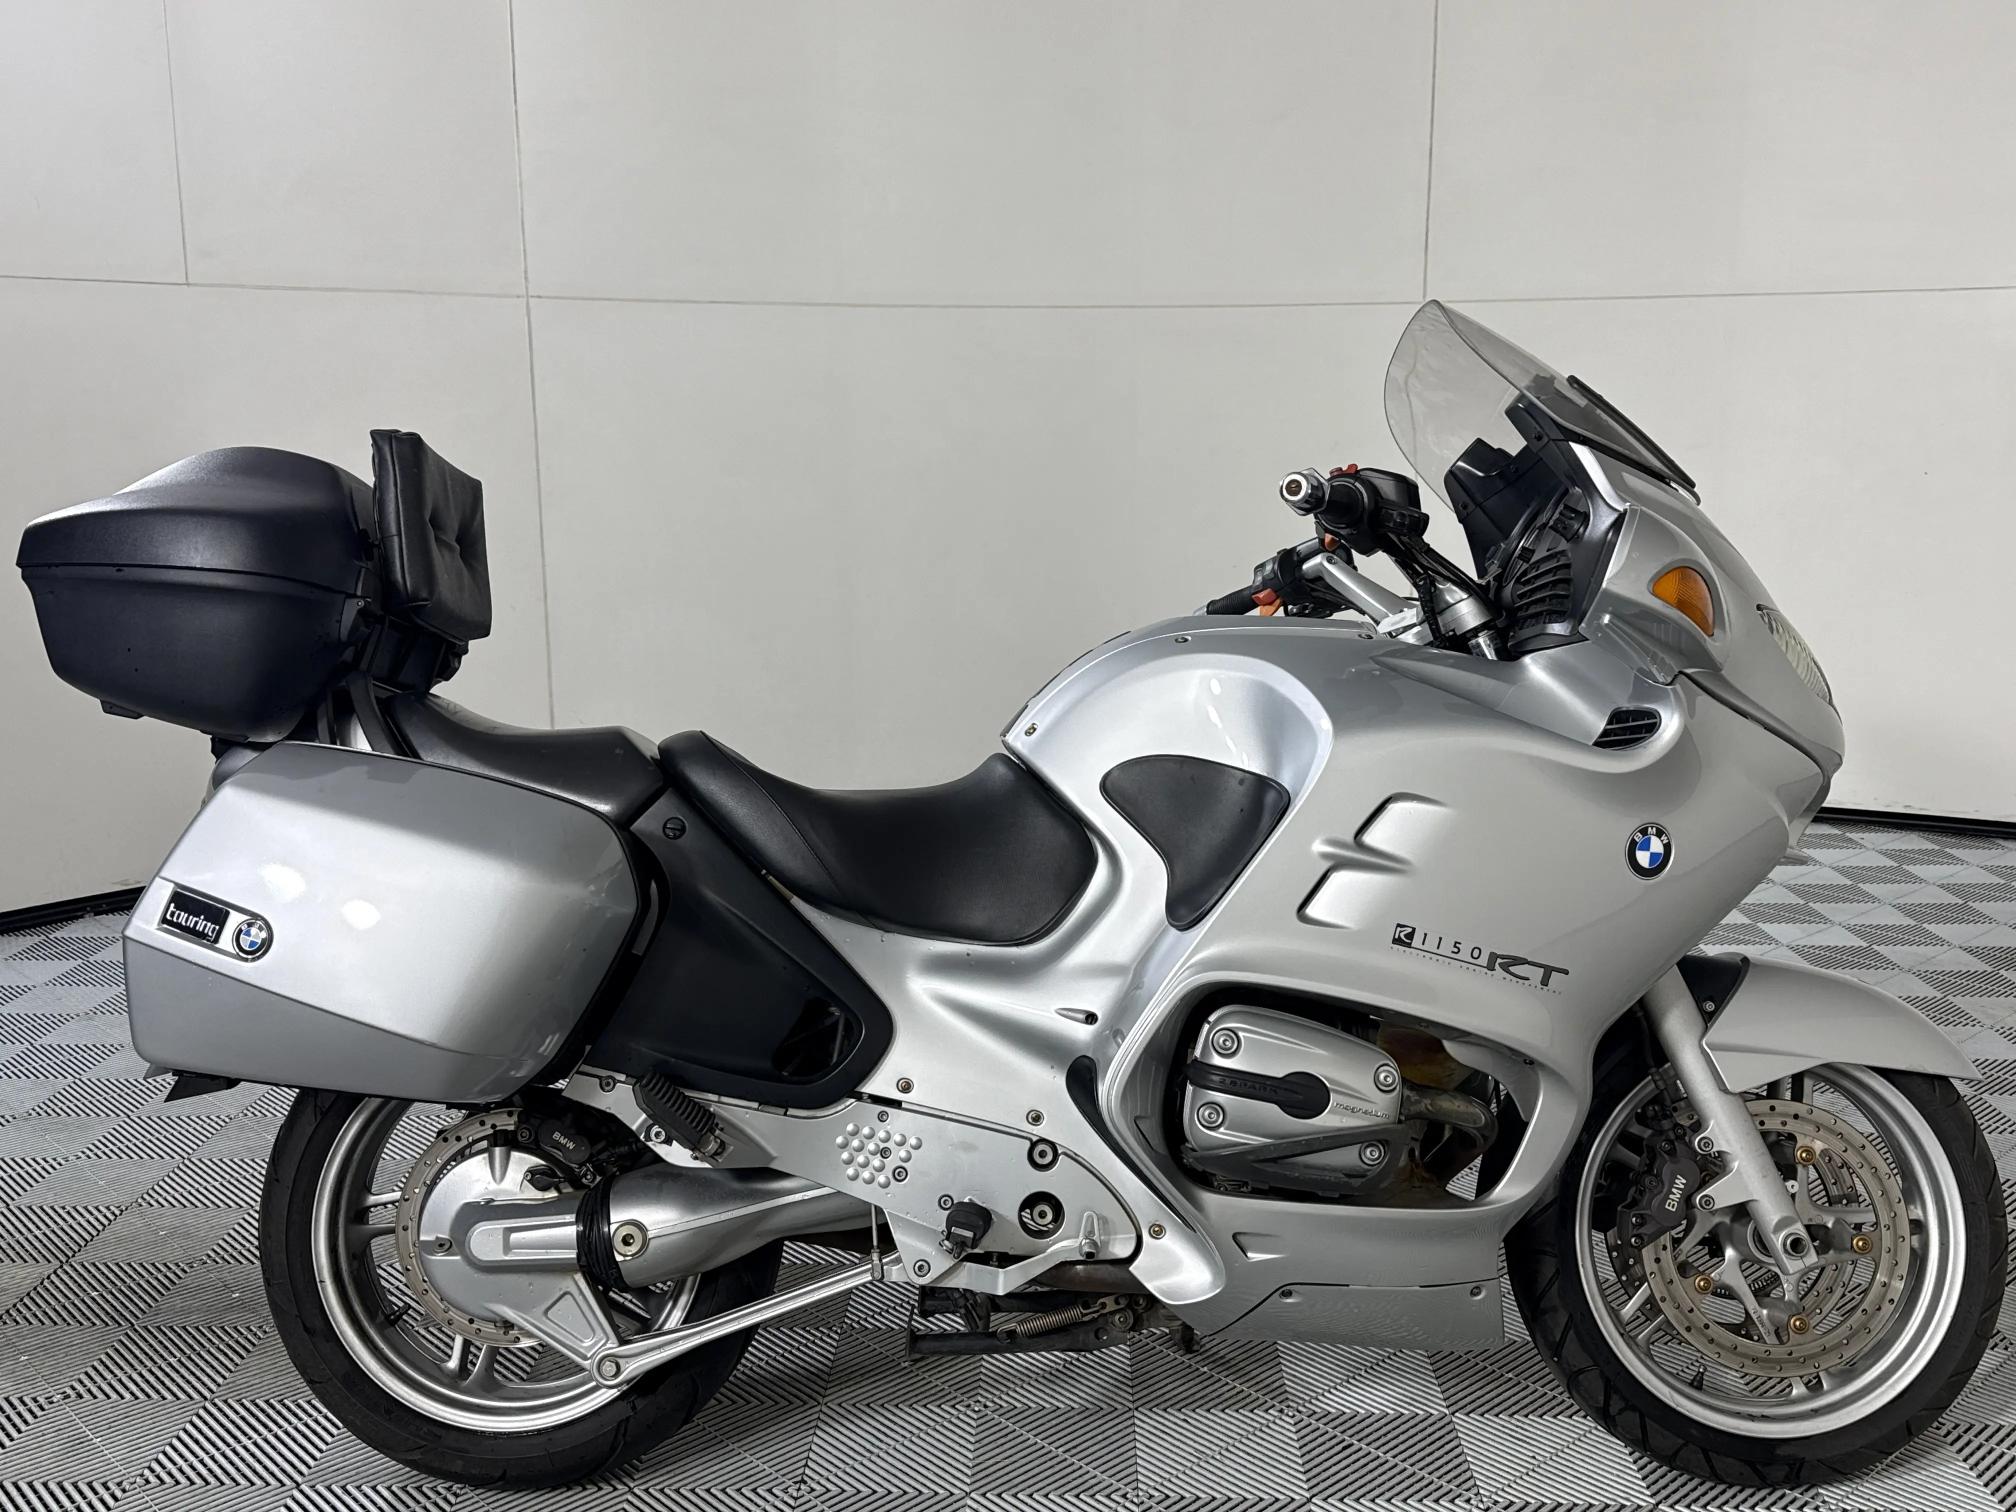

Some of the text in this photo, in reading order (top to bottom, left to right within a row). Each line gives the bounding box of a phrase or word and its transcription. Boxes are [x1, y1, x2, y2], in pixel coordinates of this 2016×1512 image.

[1633, 827, 1669, 845] BMW
[166, 903, 219, 942] touring
[552, 1131, 576, 1150] BMW
[1665, 1174, 1687, 1212] BMW
